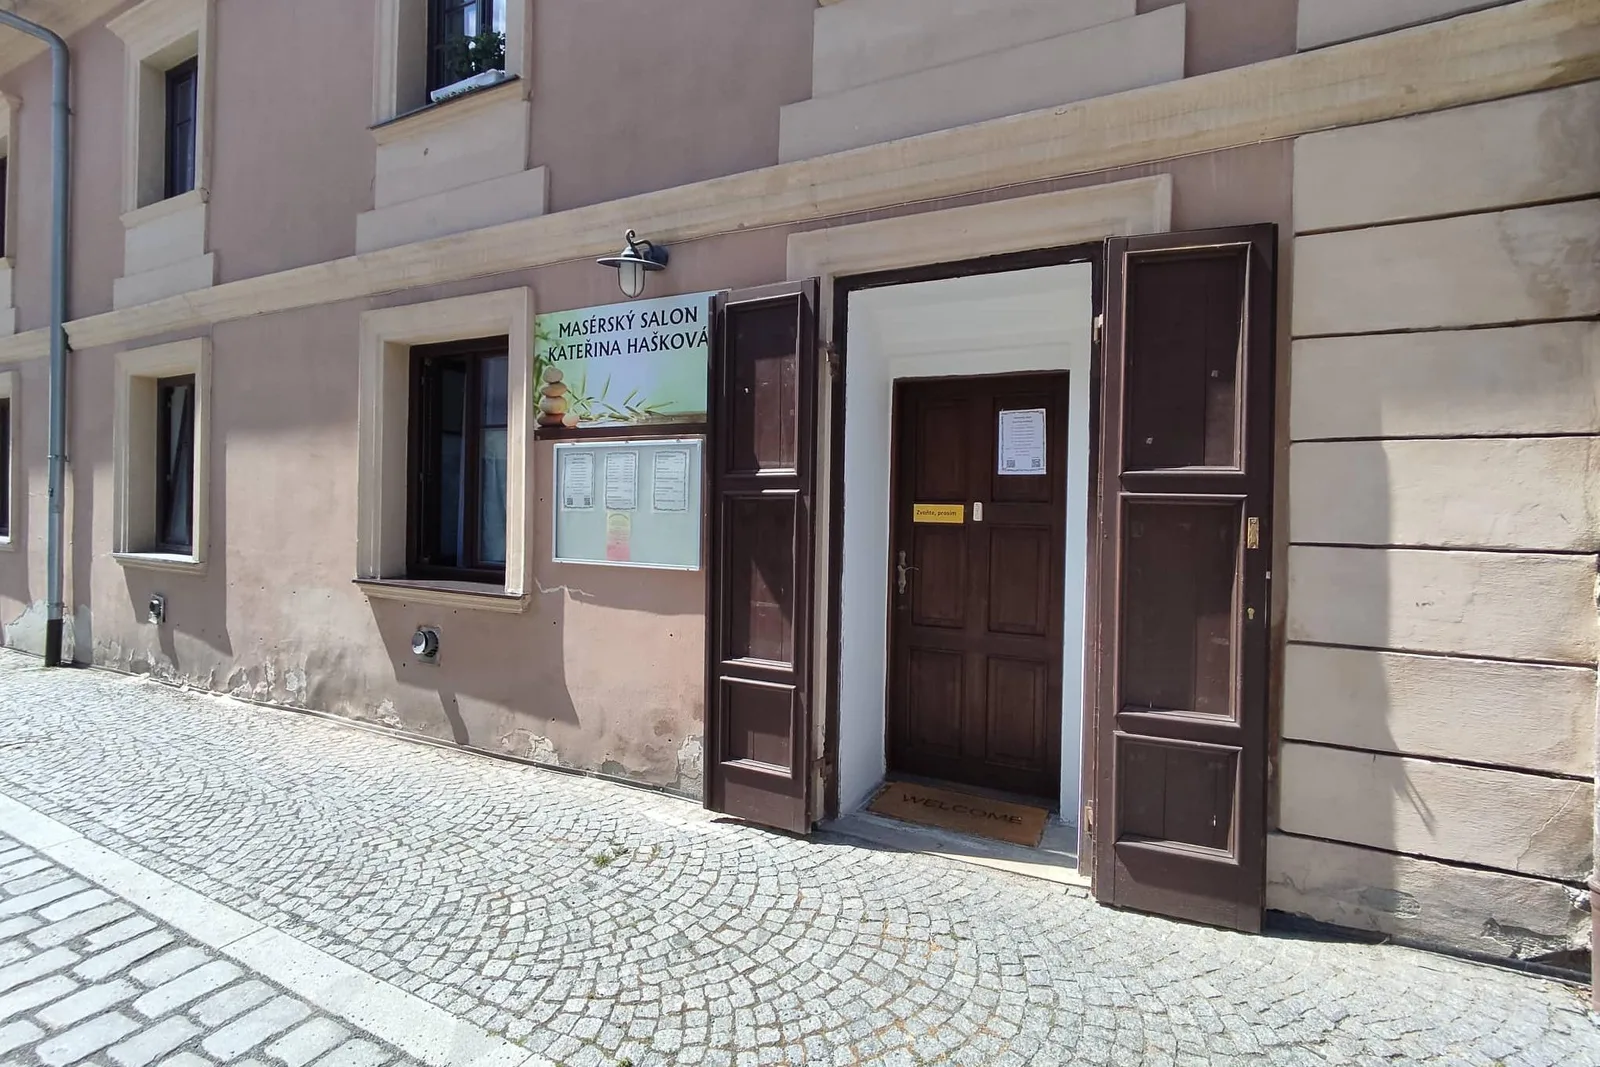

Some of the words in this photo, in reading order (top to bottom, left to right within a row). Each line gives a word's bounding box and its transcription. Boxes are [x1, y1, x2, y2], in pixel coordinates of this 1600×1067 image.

[559, 310, 635, 338] MASÉRSKÝ
[640, 306, 698, 329] SALON
[548, 339, 621, 362] KATEŘINA
[627, 326, 708, 354] HAŠKOVÁ
[937, 509, 957, 517] prosím
[903, 794, 1023, 825] WELCOME
